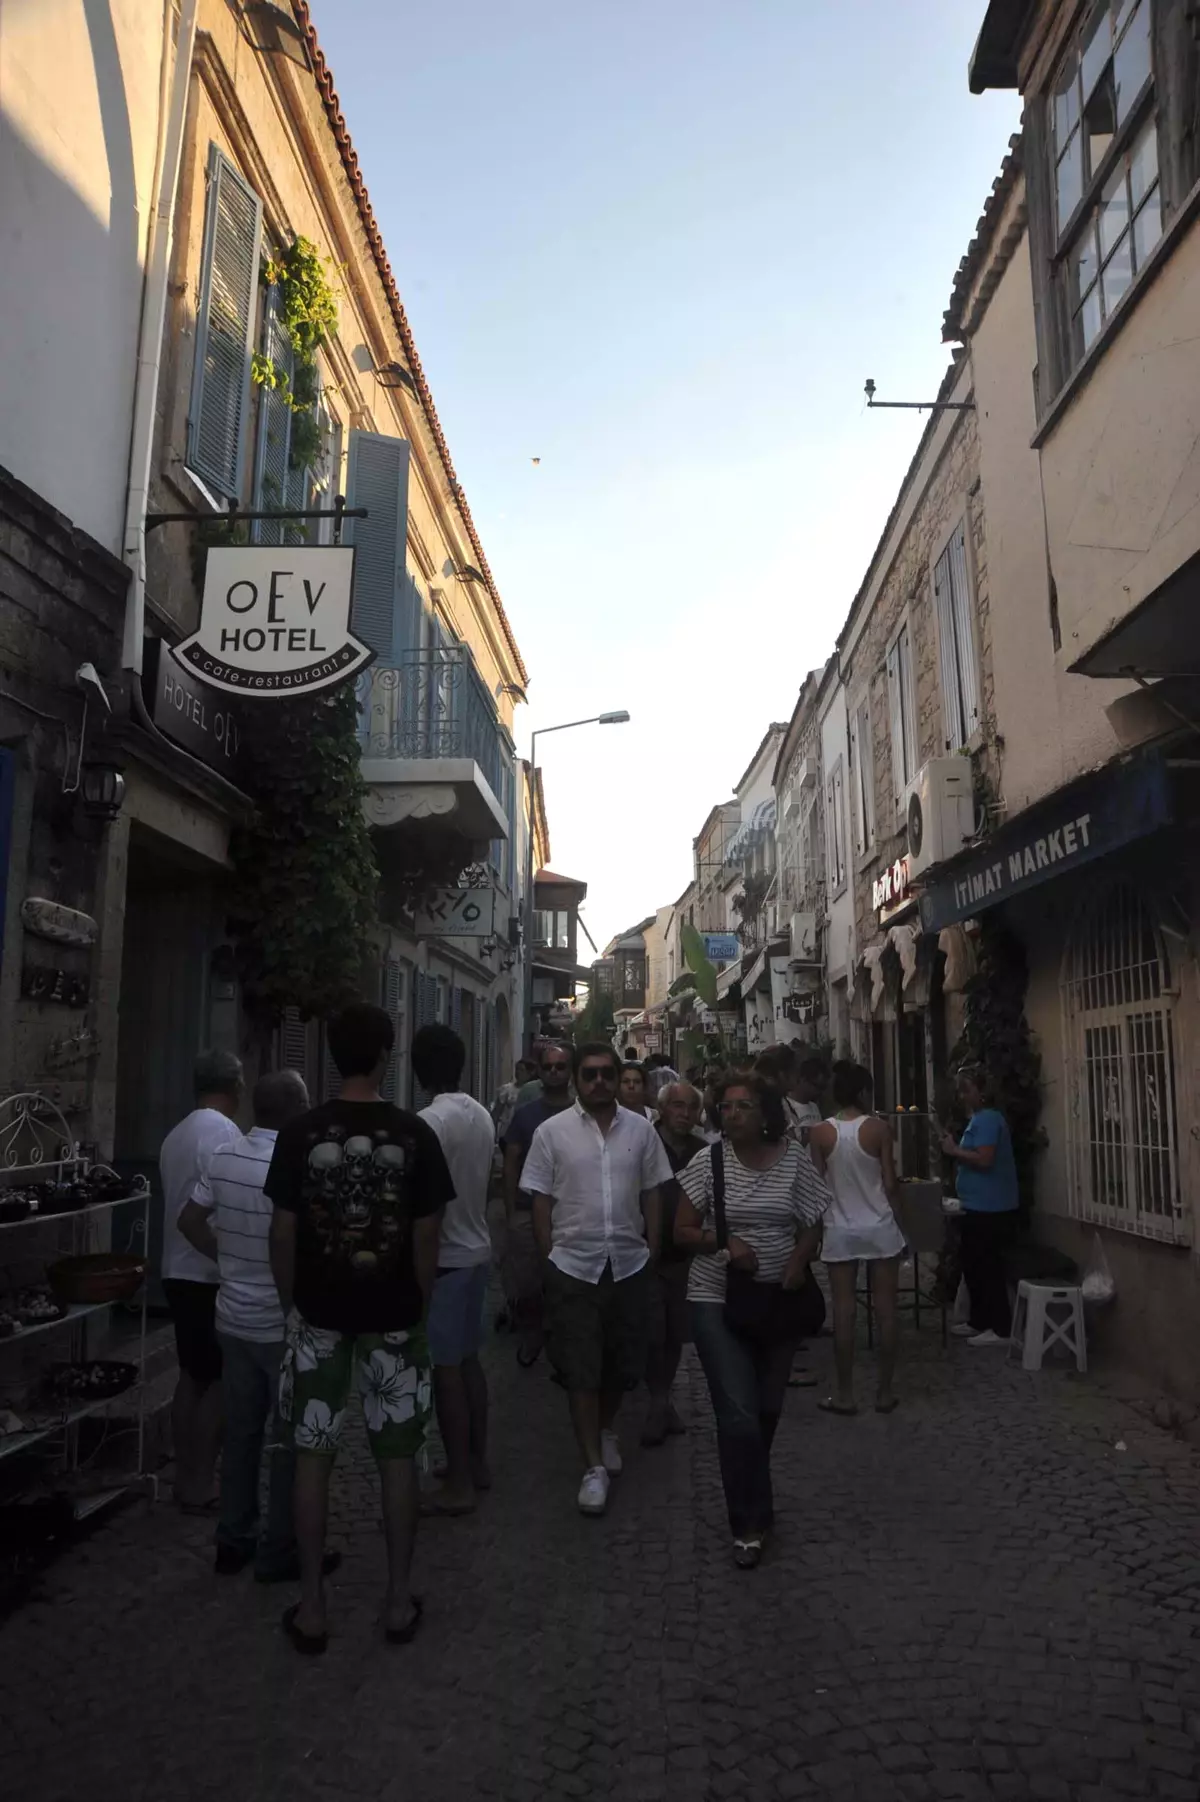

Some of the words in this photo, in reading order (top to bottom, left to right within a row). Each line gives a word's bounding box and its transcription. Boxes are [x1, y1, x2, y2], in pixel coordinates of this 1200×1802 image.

[227, 571, 326, 623] OEV
[220, 628, 326, 652] HOTEL
[203, 658, 338, 687] cafe-restaurant
[163, 675, 208, 731] HOTEL
[1008, 813, 1091, 882] MARKET
